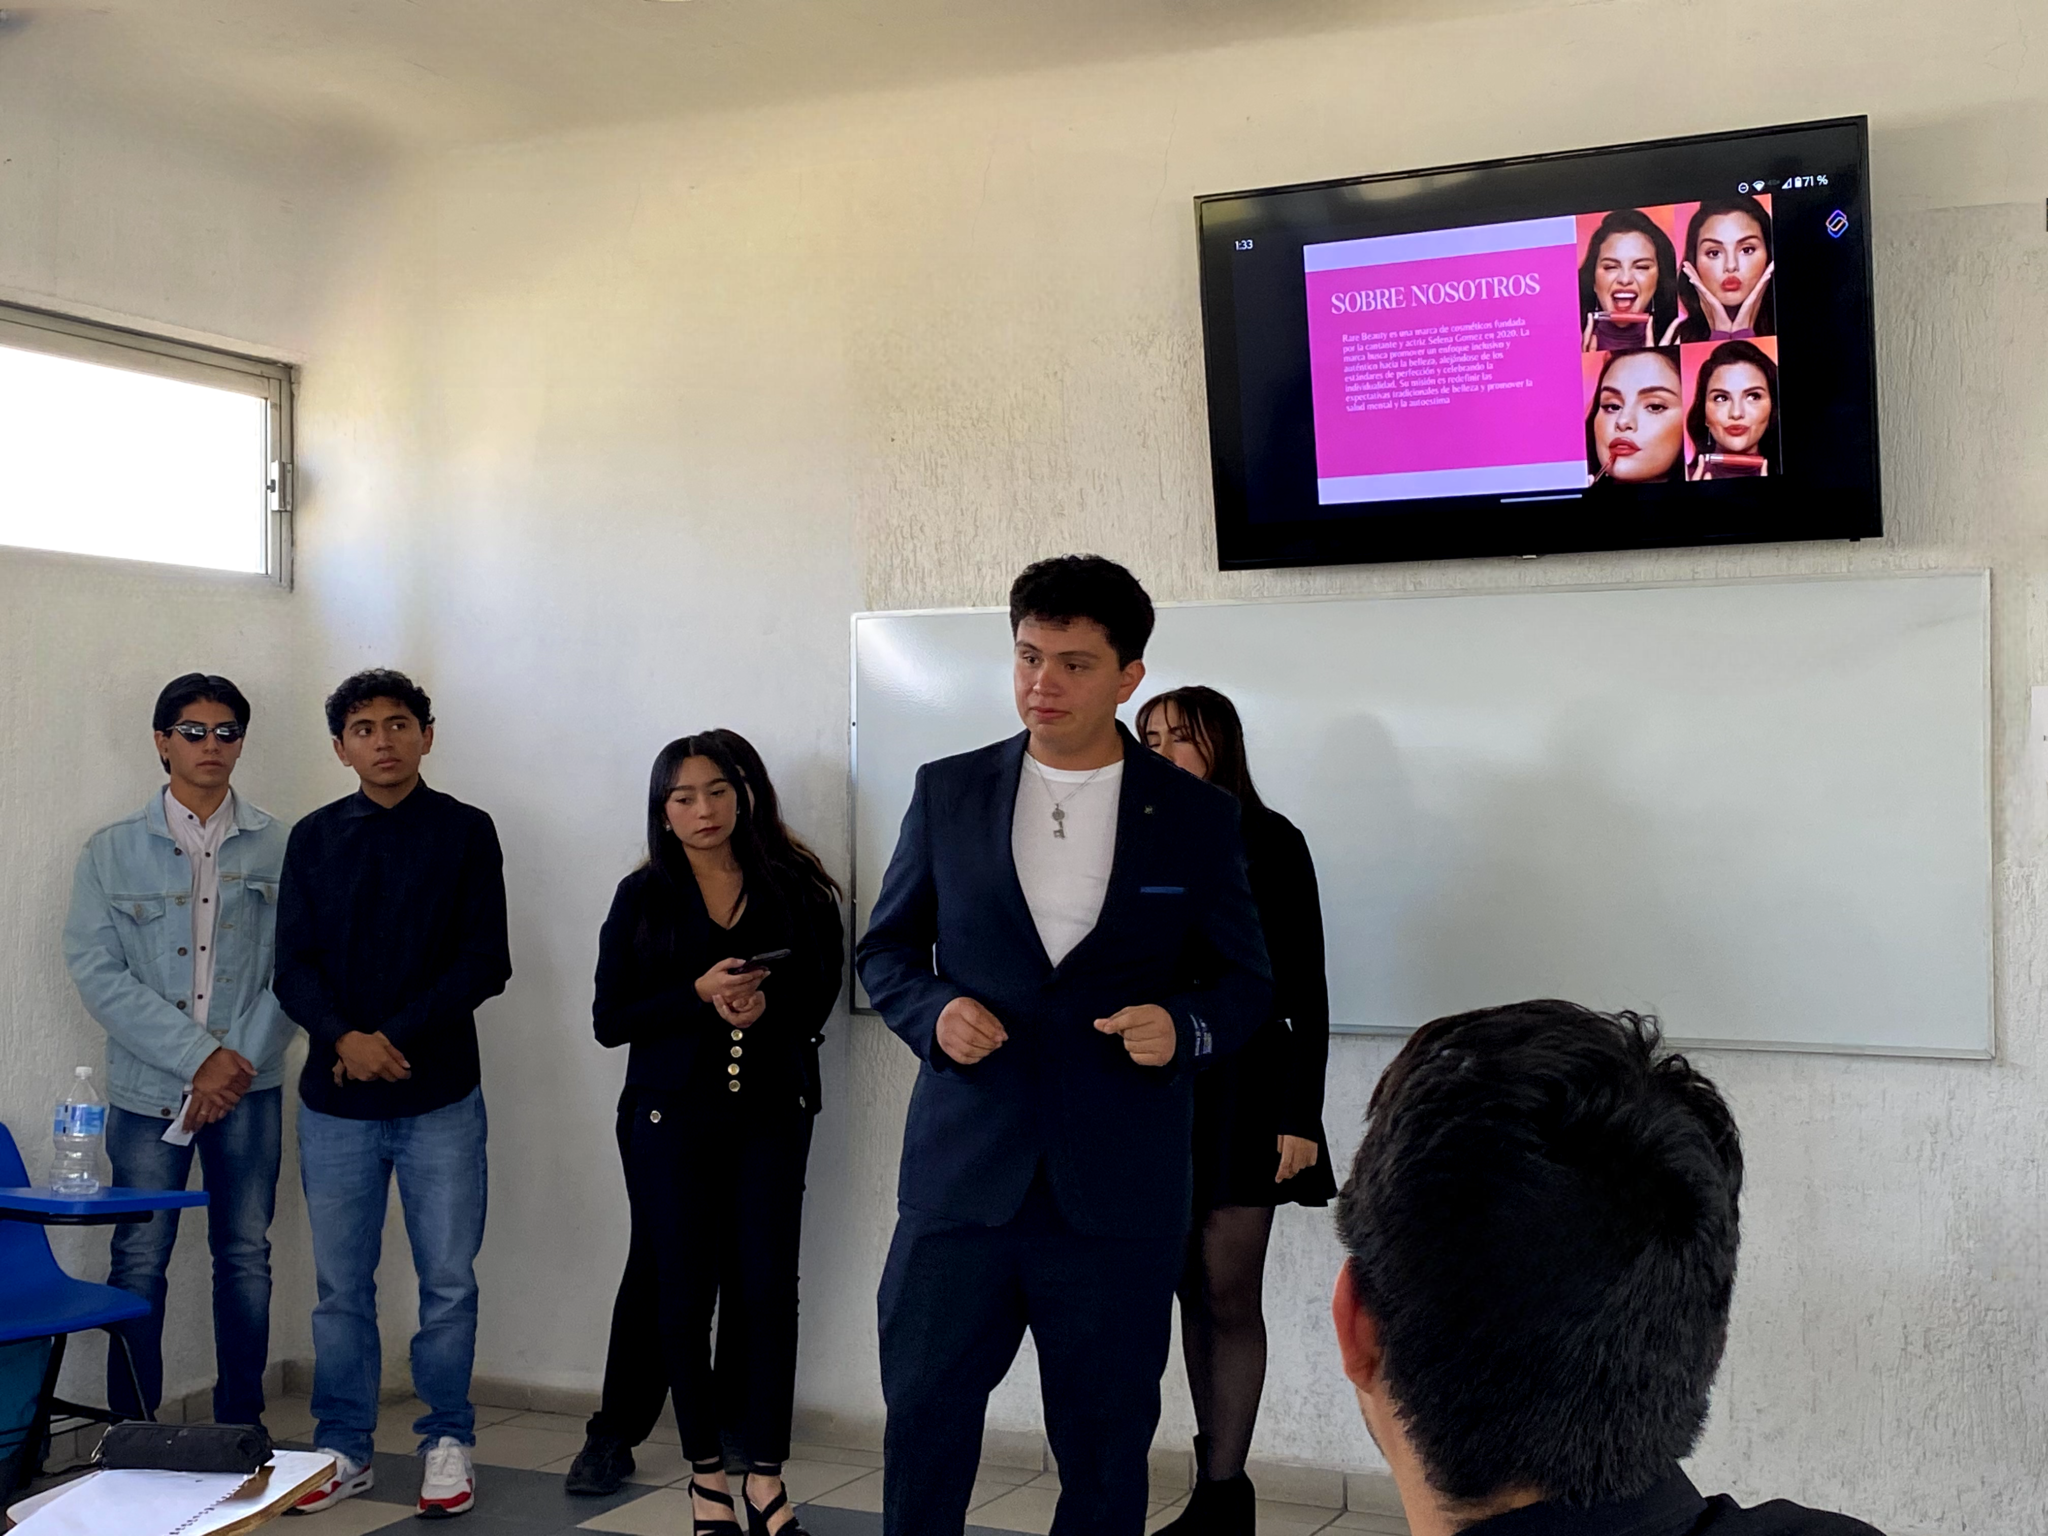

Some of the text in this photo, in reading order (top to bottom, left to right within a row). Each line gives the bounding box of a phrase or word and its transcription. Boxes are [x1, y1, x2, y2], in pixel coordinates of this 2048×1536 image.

[1802, 175, 1814, 187] 71
[1235, 239, 1254, 250] 1:33
[1331, 272, 1541, 315] SOBRE NOSOTROS
[1342, 334, 1360, 342] Rare
[1361, 332, 1388, 342] Beauty
[1414, 328, 1438, 336] marca
[1439, 325, 1449, 334] de
[1450, 321, 1492, 332] cosméticos
[1494, 317, 1526, 328] fundada
[1342, 346, 1355, 354] por
[1365, 341, 1398, 350] cantante
[1405, 338, 1426, 347] actriz
[1428, 334, 1454, 345] Selena
[1454, 333, 1482, 342] Gomez
[1496, 330, 1518, 338] 2020.
[1520, 328, 1530, 336] La
[1344, 354, 1366, 362] marca
[1367, 352, 1388, 360] busca
[1390, 349, 1425, 360] promover
[1438, 344, 1470, 354] enfoque
[1471, 341, 1504, 350] inclusivo
[1506, 341, 1511, 350] y
[1379, 360, 1398, 368] hacia
[1400, 360, 1407, 368] la
[1480, 351, 1490, 360] de
[1492, 351, 1504, 360] los
[1385, 370, 1394, 378] de
[1396, 367, 1435, 379] perfección
[1443, 362, 1485, 374] celebrando
[1486, 362, 1494, 370] la
[1399, 379, 1409, 388] Su
[1411, 376, 1436, 386] misión
[1448, 374, 1480, 384] redefinir
[1482, 372, 1492, 380] las
[1346, 391, 1390, 404] expectativas
[1440, 386, 1450, 394] de
[1452, 384, 1479, 393] belleza
[1487, 381, 1524, 392] promover
[1526, 378, 1533, 387] la
[1346, 402, 1366, 412] salud
[1366, 400, 1392, 410] mental
[1400, 399, 1408, 408] la
[1408, 397, 1450, 407] autoestima
